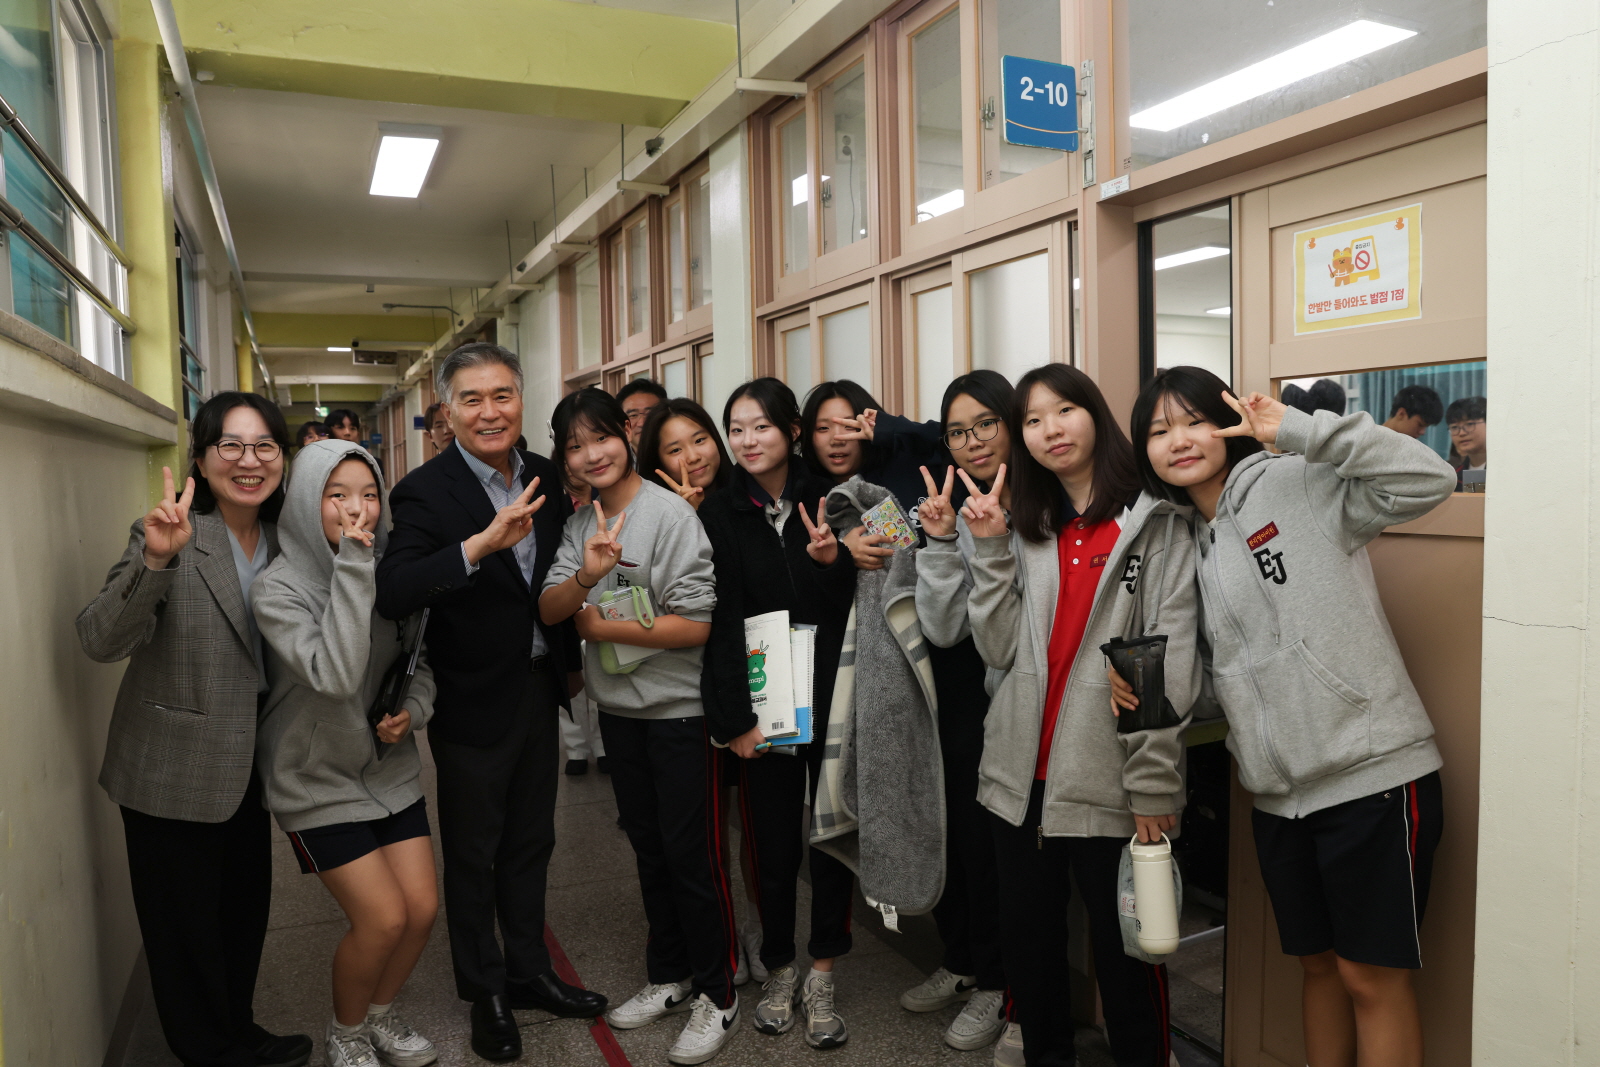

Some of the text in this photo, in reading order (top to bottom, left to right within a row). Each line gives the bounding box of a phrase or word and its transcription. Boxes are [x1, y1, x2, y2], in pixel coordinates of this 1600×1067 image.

[1020, 76, 1068, 107] 2-10
[1308, 288, 1405, 314] 한발만 들어와도 벌점 1점
[1253, 547, 1287, 585] EJ
